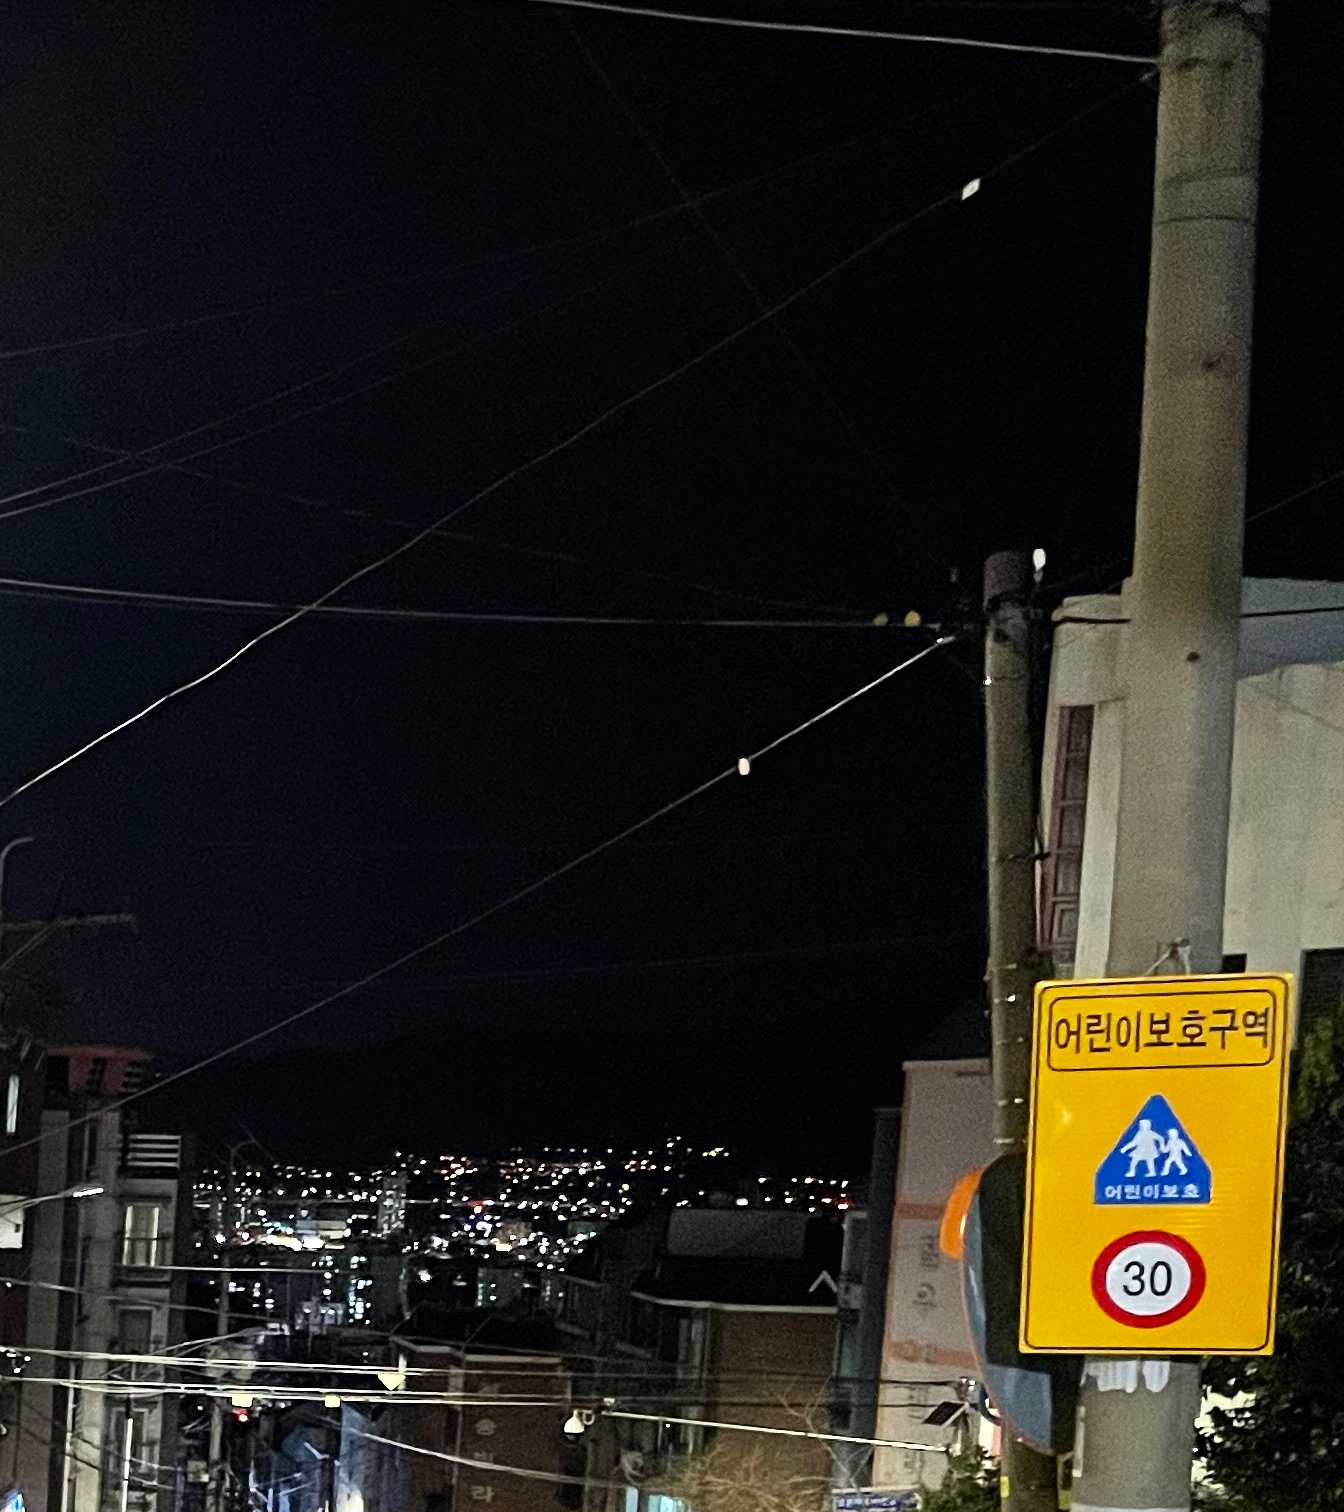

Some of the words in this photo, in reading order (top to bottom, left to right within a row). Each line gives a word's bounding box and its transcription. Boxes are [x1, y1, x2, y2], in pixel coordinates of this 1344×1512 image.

[1054, 1007, 1271, 1054] 어린이보호구역
[1104, 1183, 1201, 1200] 어린이보호
[1122, 1260, 1173, 1297] 30
